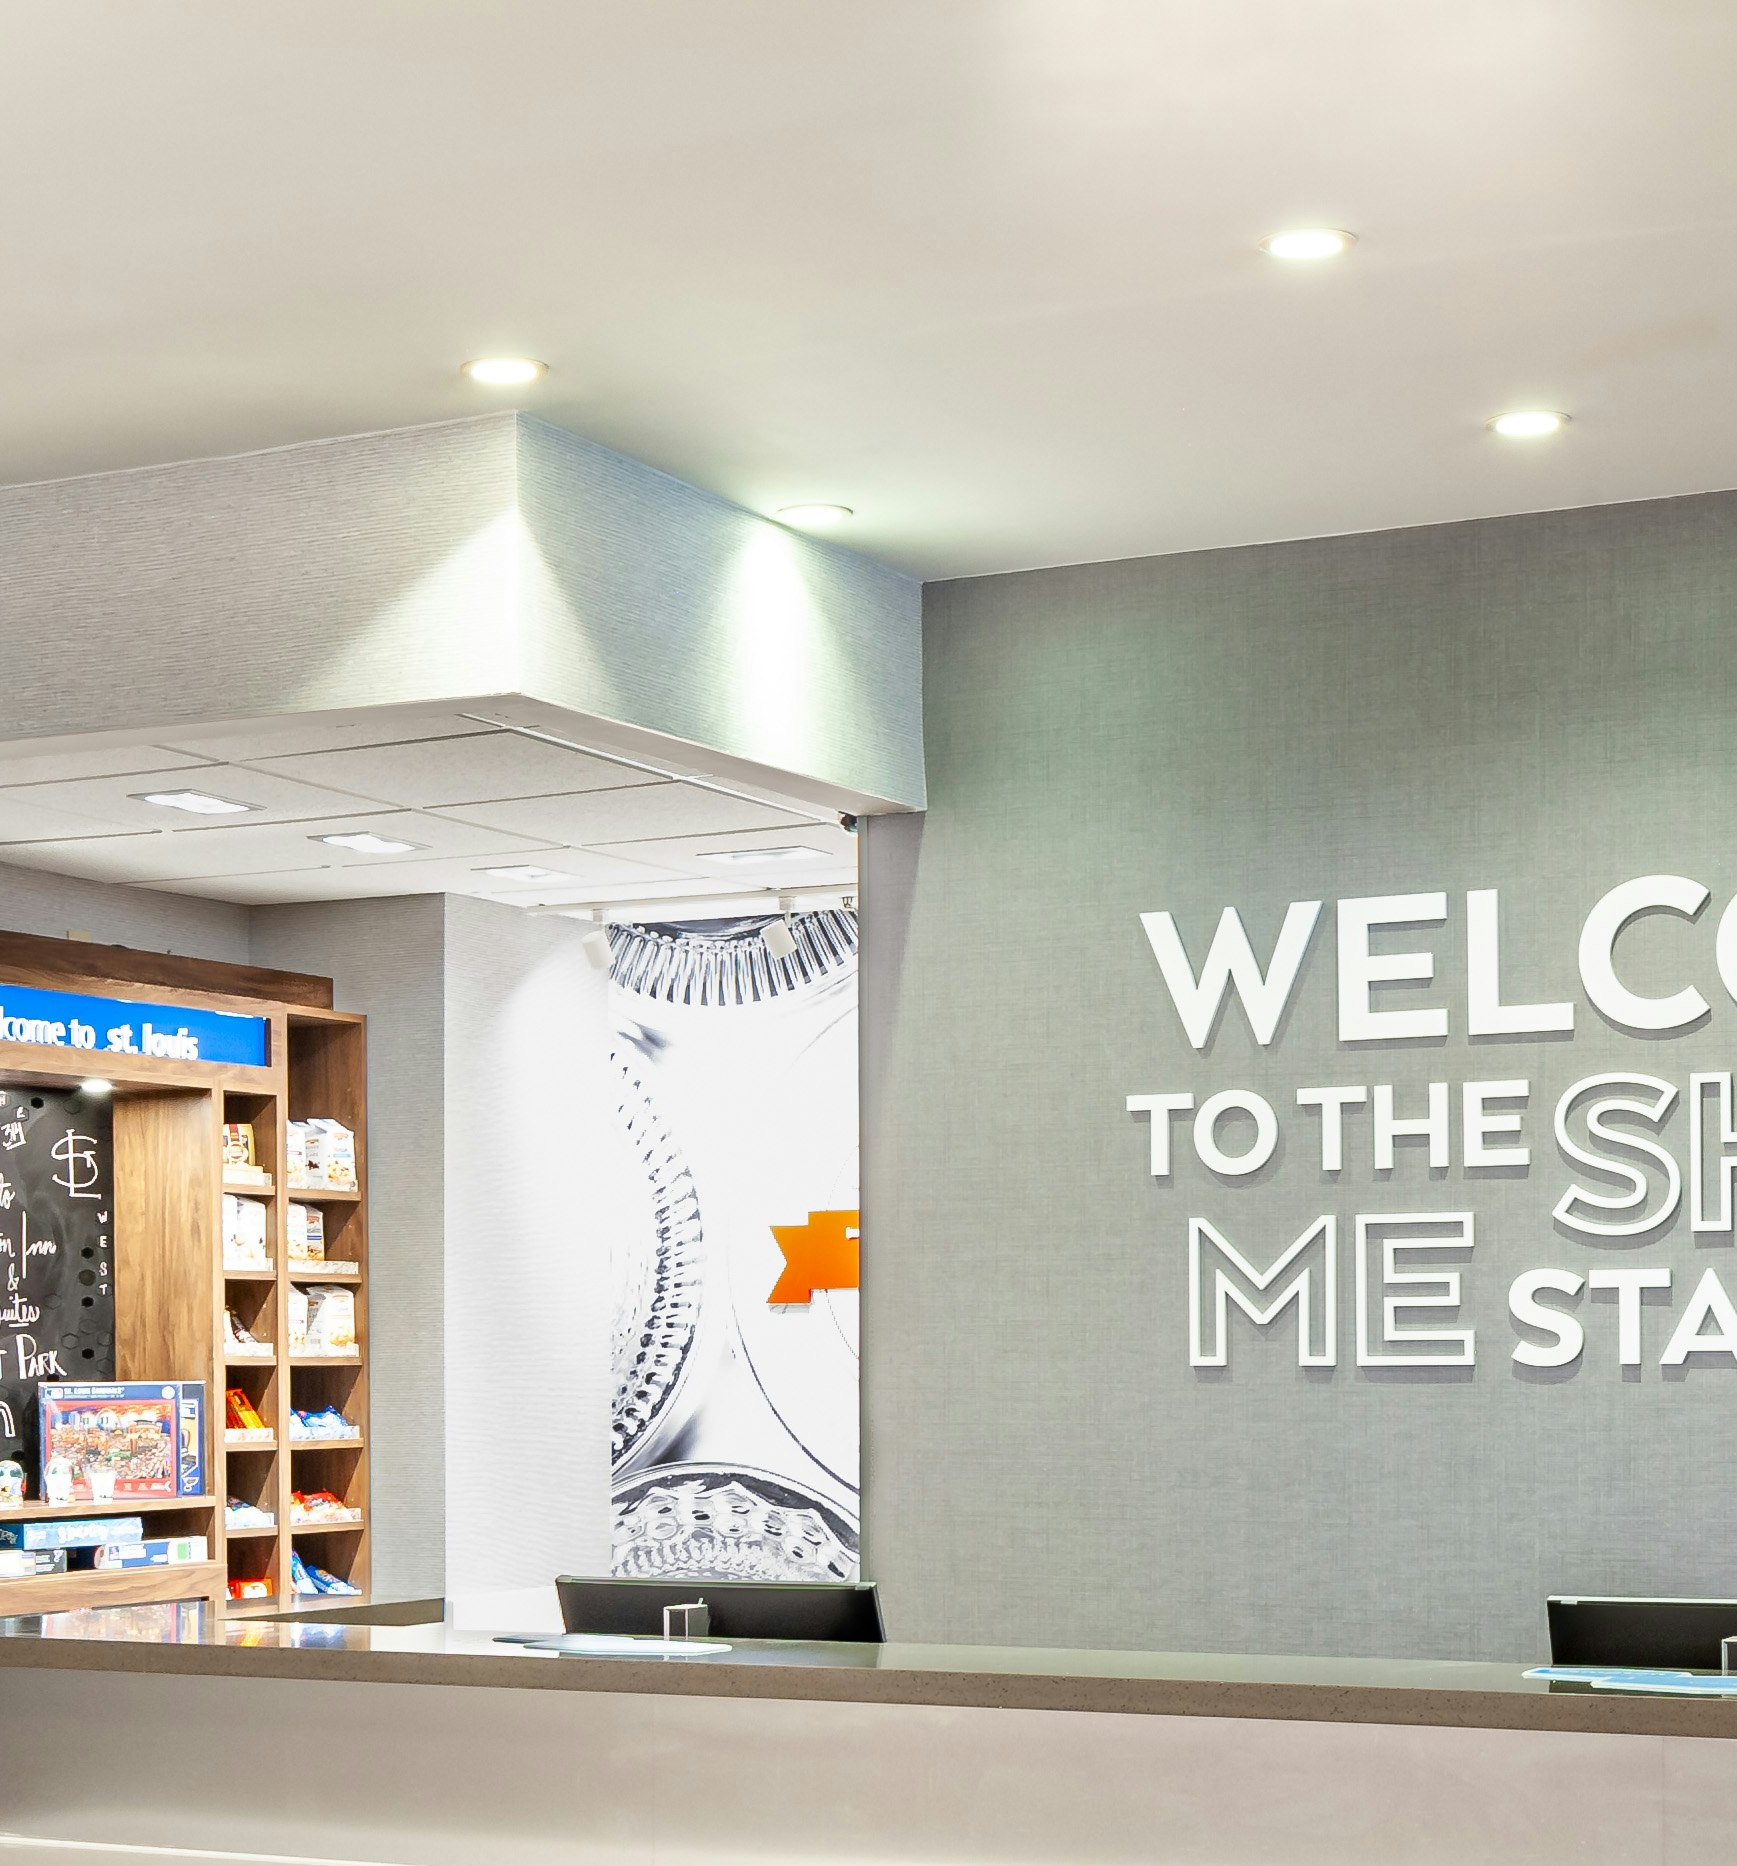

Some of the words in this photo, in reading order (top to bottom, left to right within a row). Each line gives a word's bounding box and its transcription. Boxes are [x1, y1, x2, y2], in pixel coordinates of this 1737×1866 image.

[68, 1018, 96, 1050] to
[107, 1024, 138, 1054] st.
[142, 1022, 199, 1061] louis
[1126, 1089, 1279, 1176] TO
[1297, 1079, 1530, 1172] THE
[22, 1210, 57, 1279] Inn
[1188, 1211, 1475, 1367] ME
